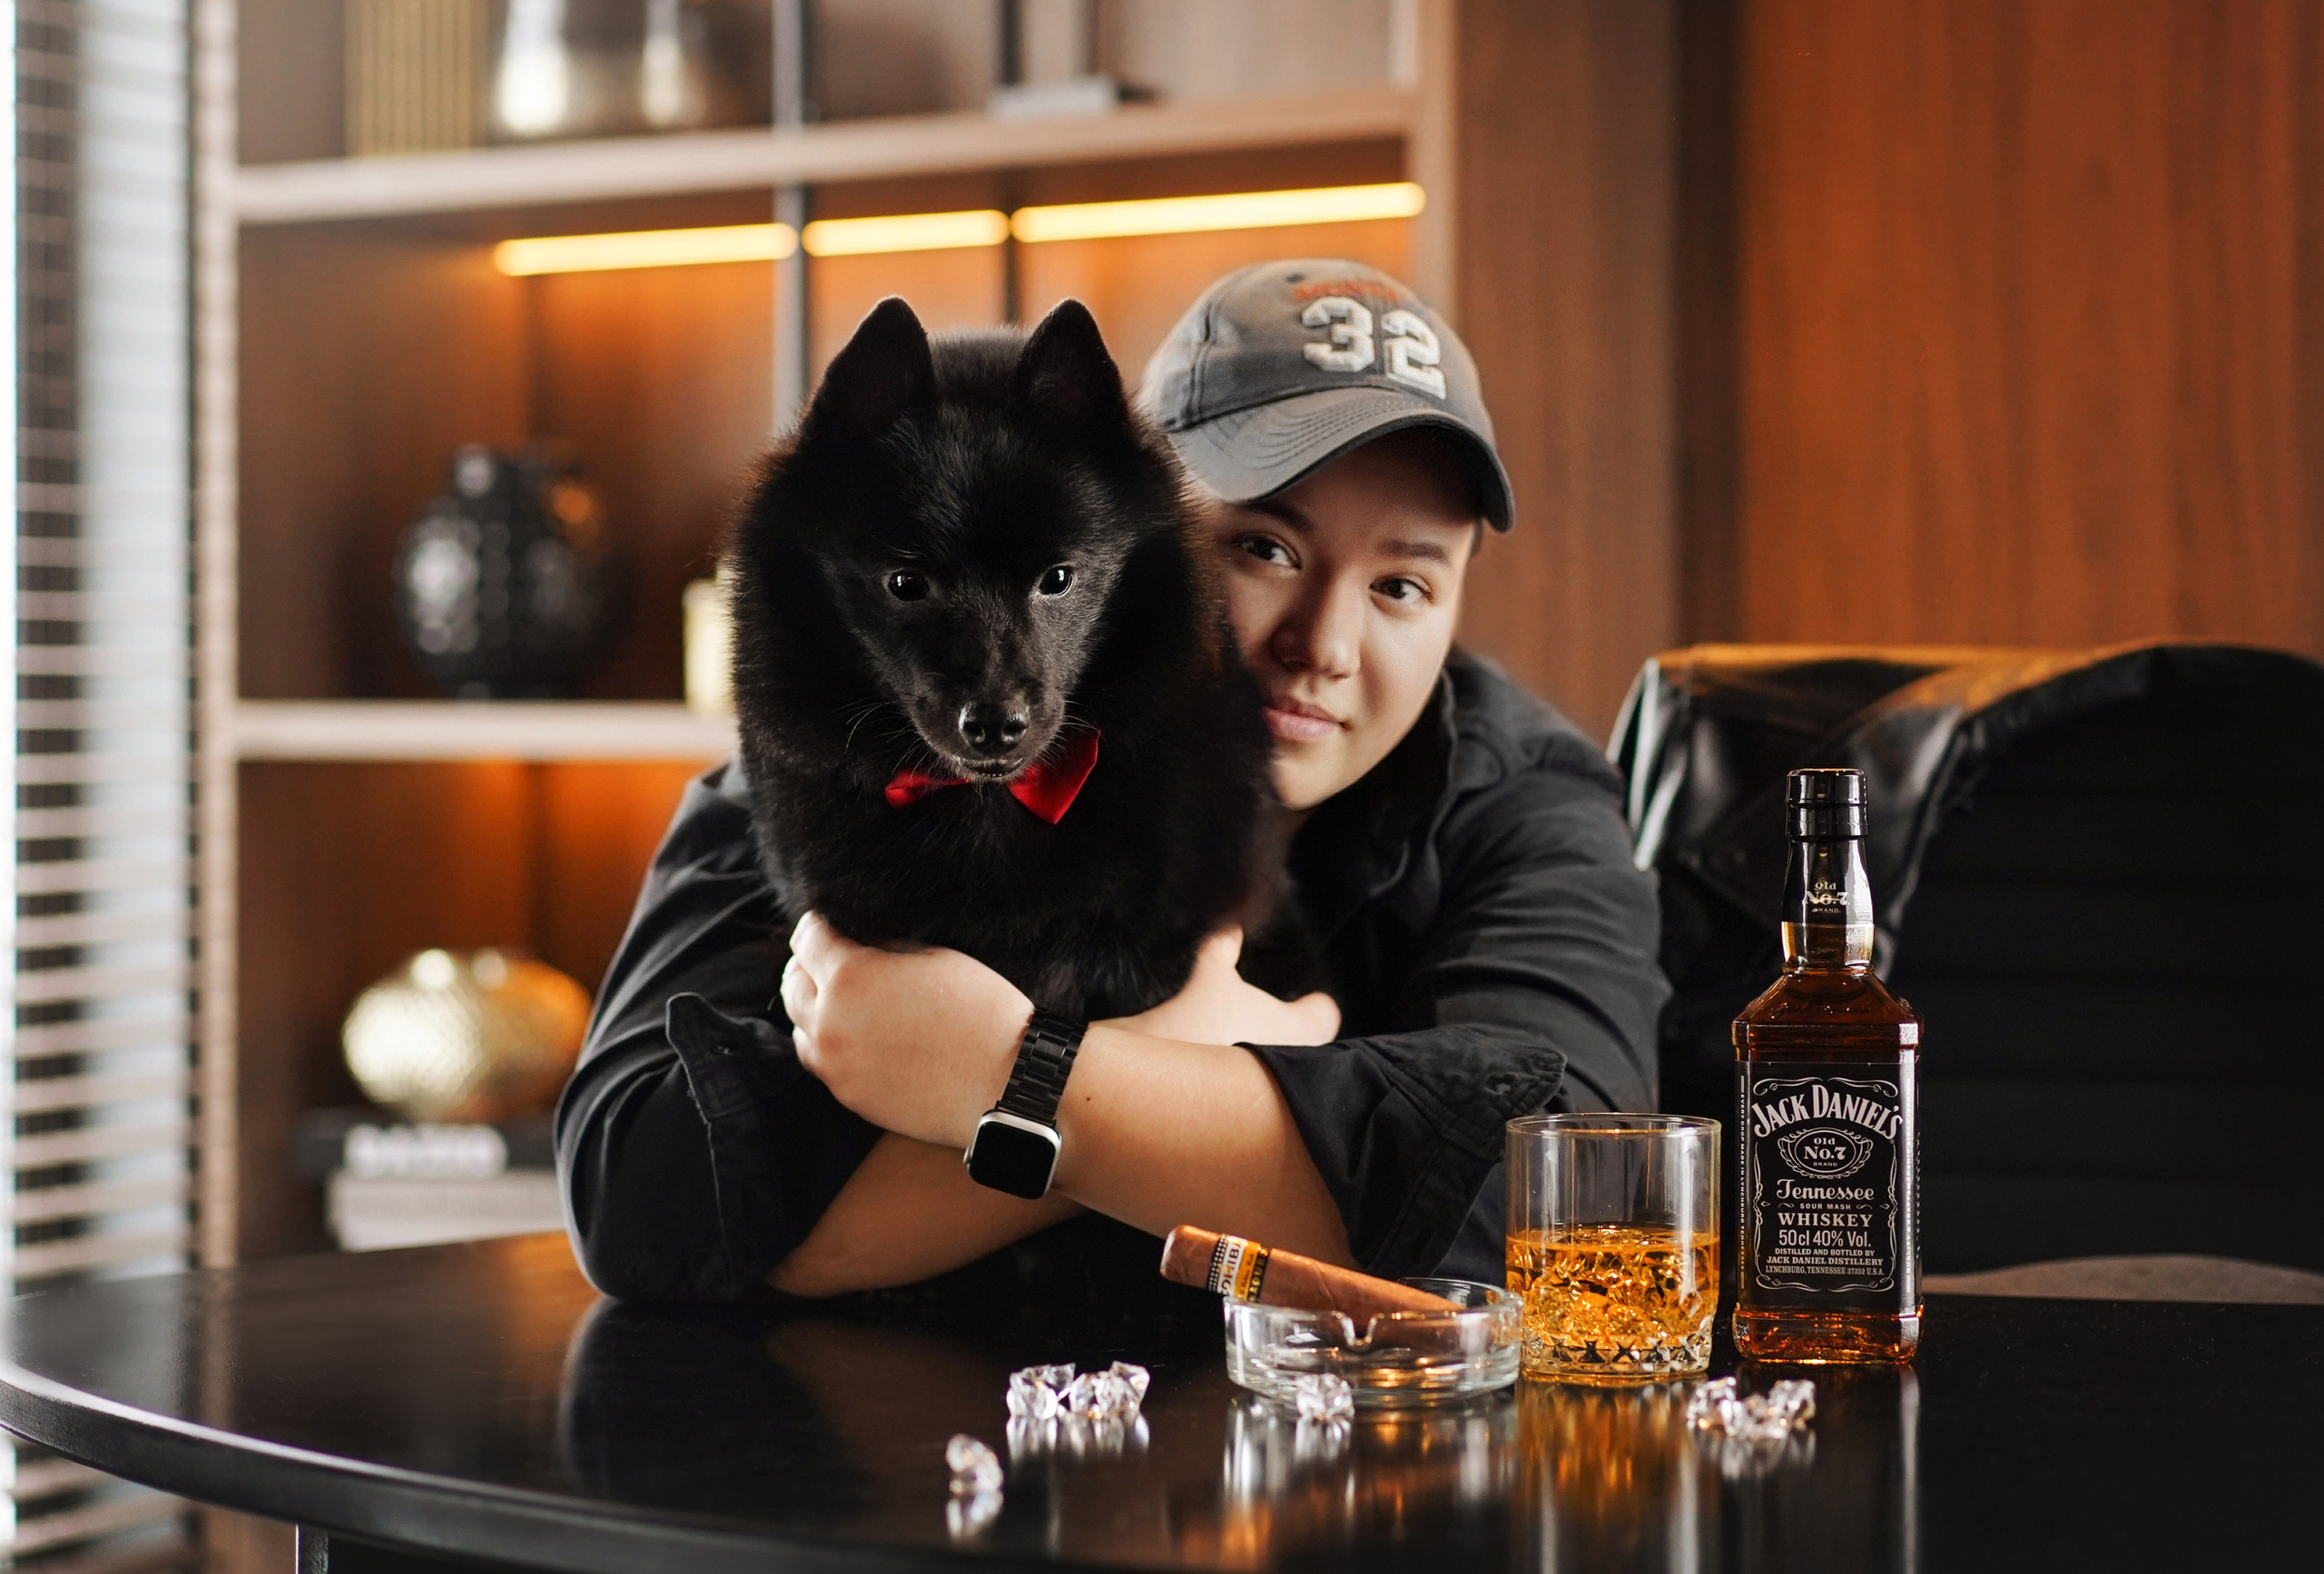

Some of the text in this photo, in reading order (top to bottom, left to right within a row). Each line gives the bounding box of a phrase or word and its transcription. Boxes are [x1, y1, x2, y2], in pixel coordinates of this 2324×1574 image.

[1302, 296, 1446, 399] 32
[1814, 880, 1837, 890] Old
[1751, 1084, 1904, 1140] JACK DANIEL'S
[1814, 1136, 1837, 1145] Old
[1803, 1146, 1846, 1160] No.7
[1740, 1166, 1745, 1176] IN
[1777, 1178, 1875, 1200] Tennessee
[1777, 1213, 1873, 1227] WHISKEY
[1779, 1229, 1872, 1247] 50cl 40% Vol.
[1775, 1247, 1812, 1255] DISTILLED
[1792, 1256, 1827, 1264] DANIEL
[1827, 1257, 1884, 1265] DISTILLERY
[1766, 1265, 1807, 1274] LYNCHBURG,
[1807, 1266, 1846, 1274] TENNESSEE
